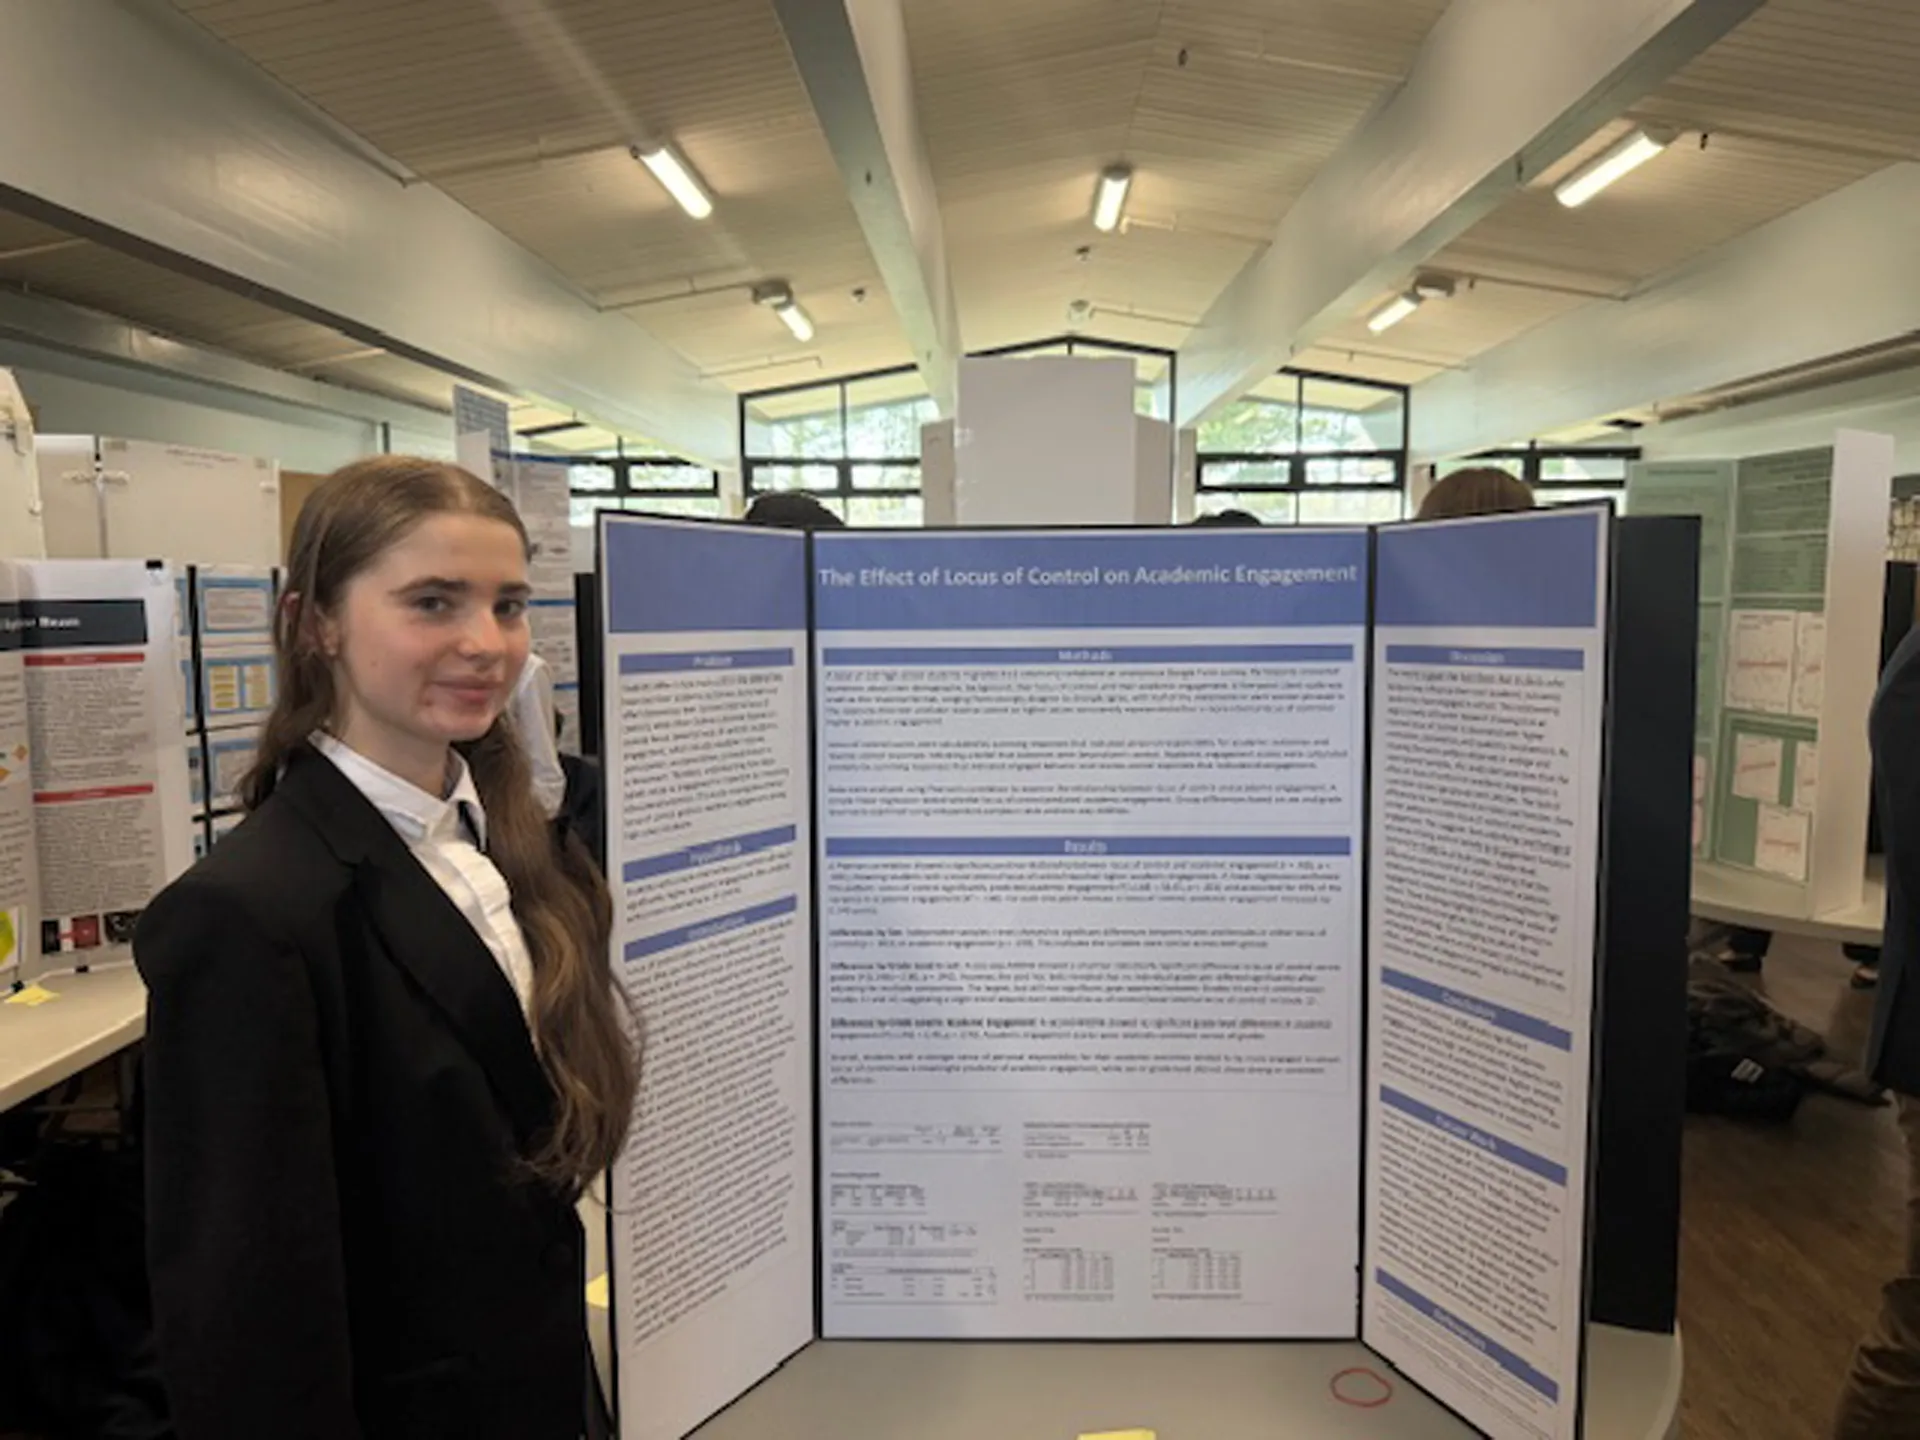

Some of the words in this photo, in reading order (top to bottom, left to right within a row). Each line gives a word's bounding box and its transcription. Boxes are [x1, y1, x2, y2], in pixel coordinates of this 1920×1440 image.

[819, 568, 854, 587] The
[860, 567, 915, 586] Effect
[919, 567, 940, 586] of
[945, 568, 999, 586] Locus
[1003, 567, 1024, 586] of
[1028, 566, 1100, 586] Control
[1104, 570, 1130, 585] on
[1134, 566, 1230, 585] Academic
[1235, 565, 1358, 588] Engagement
